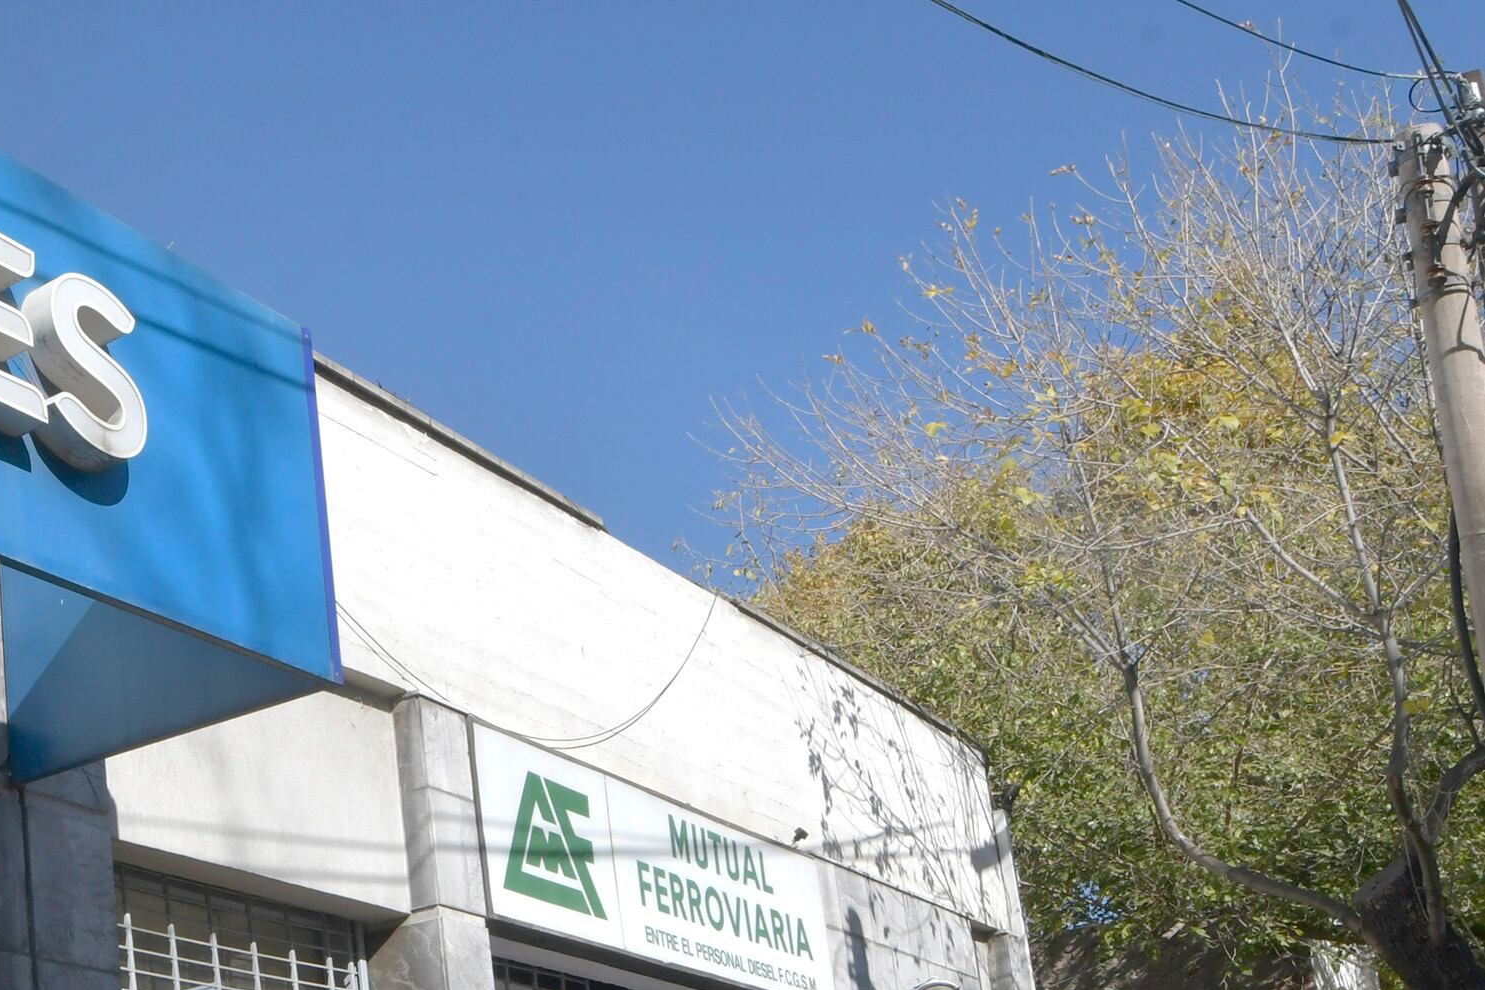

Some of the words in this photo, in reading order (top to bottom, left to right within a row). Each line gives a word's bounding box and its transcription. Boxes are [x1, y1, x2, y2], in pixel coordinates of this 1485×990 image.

[667, 813, 774, 895] MUTUAL
[636, 859, 814, 961] FERROVIARIA
[644, 925, 680, 952] ENTRE
[682, 939, 694, 955] EL
[695, 943, 747, 973] PERSONAL
[747, 956, 777, 981] DIESEL
